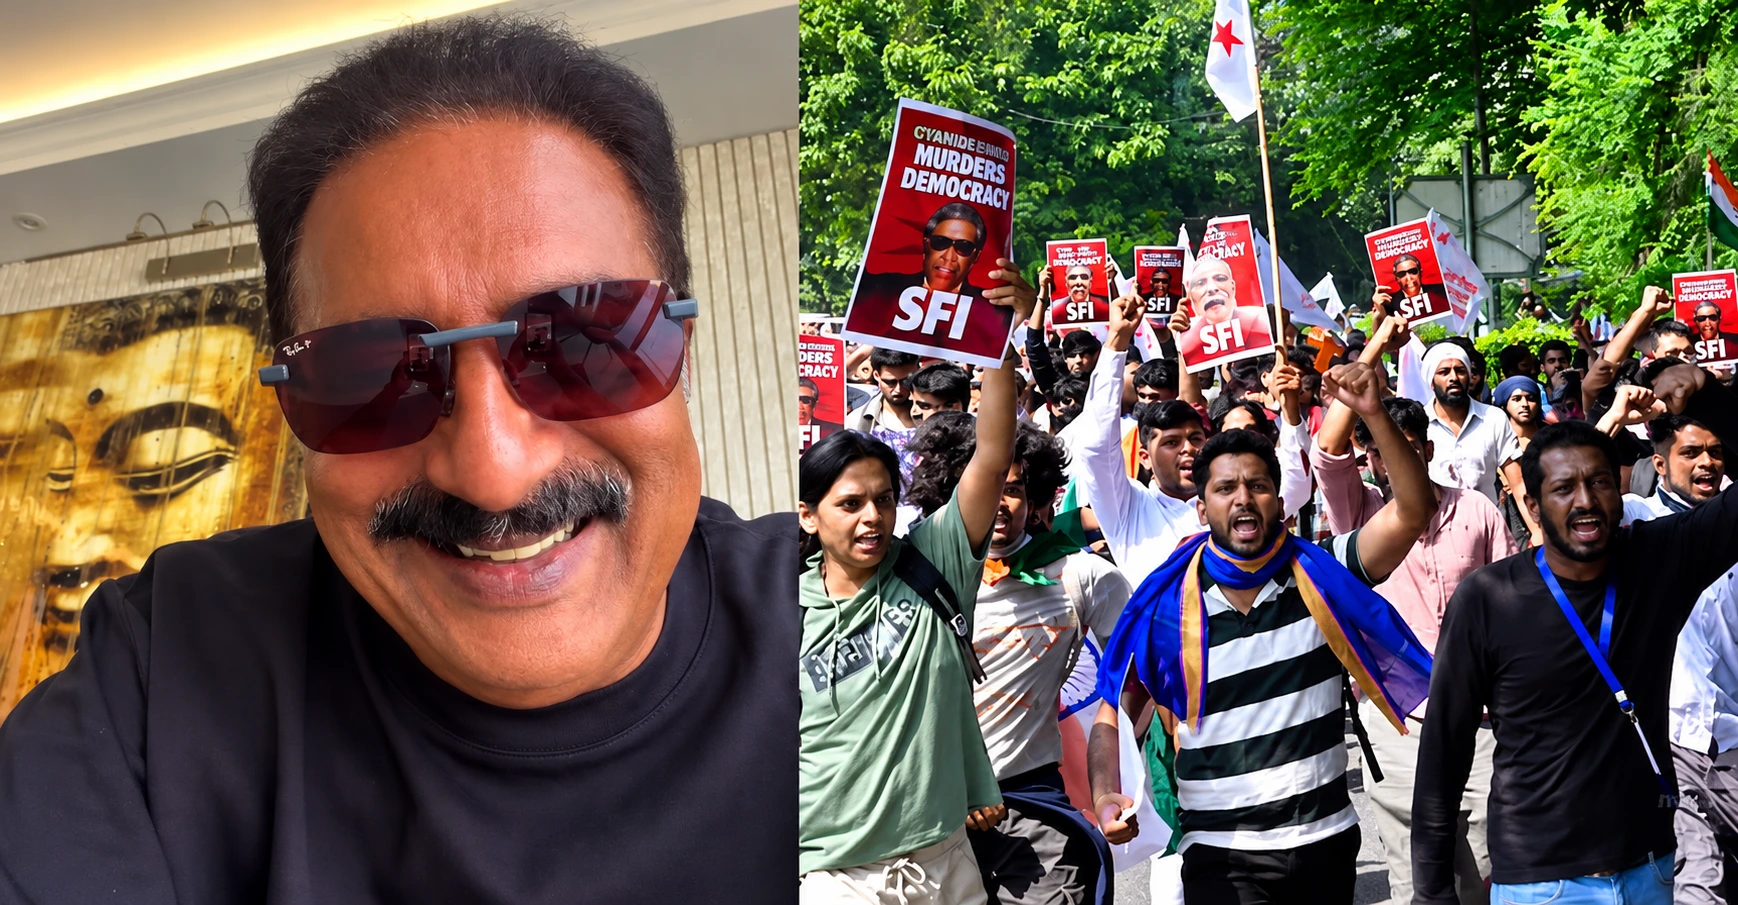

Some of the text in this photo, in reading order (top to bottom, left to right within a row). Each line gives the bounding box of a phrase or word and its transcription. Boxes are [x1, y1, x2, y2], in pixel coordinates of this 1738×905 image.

[914, 126, 976, 152] CYANIDE
[913, 142, 1006, 185] MURDERS
[900, 168, 1010, 211] DEMOCRACY
[892, 286, 974, 341] SFI
[1066, 301, 1094, 321] SFI
[1148, 297, 1170, 312] SFI
[1400, 292, 1433, 319] SFI
[1200, 318, 1245, 355] SFI
[1694, 339, 1726, 360] SFI
